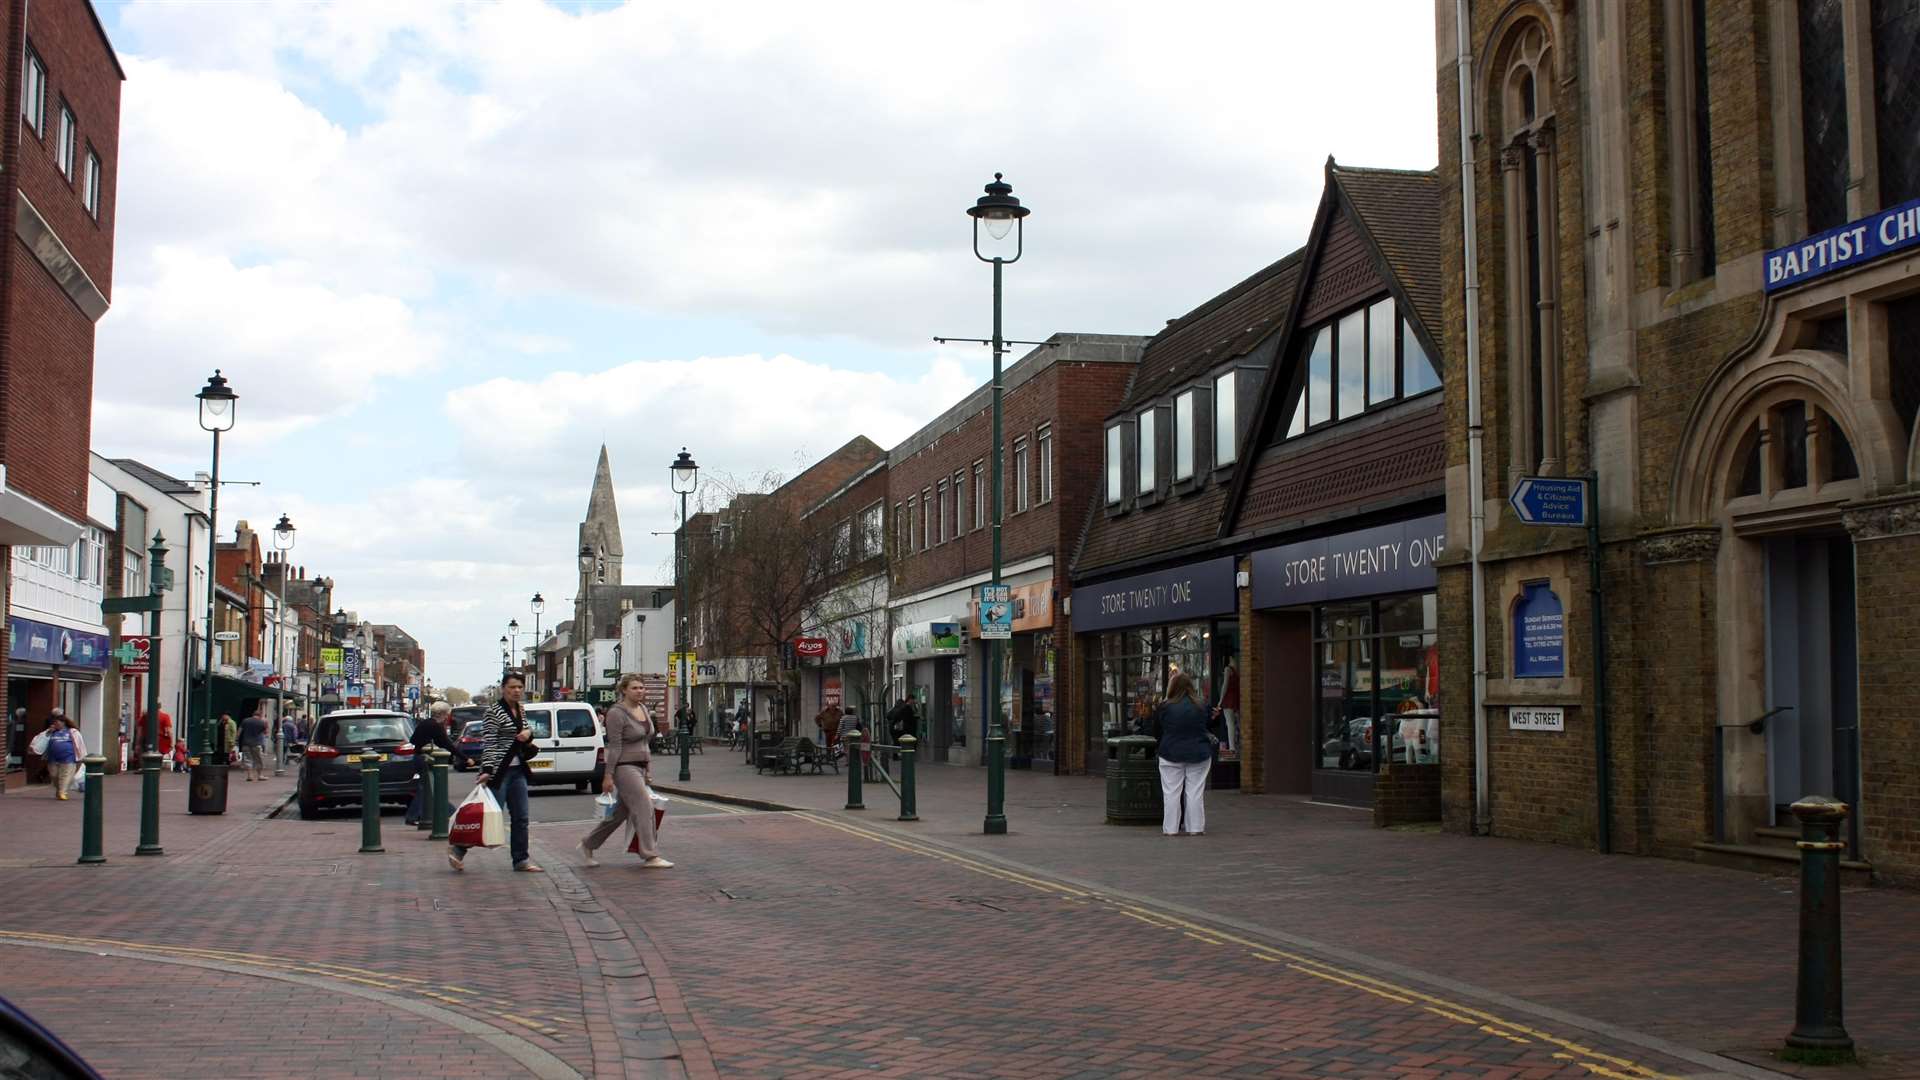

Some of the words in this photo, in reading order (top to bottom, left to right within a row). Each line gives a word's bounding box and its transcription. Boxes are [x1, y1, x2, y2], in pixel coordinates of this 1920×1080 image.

[1769, 225, 1866, 283] BAPTIST
[1879, 206, 1920, 246] CH
[1533, 484, 1566, 493] Housing
[1567, 484, 1580, 493] Aid
[1543, 493, 1576, 501] Citizens
[1542, 502, 1569, 510] Advice
[1285, 556, 1326, 587] STORE
[1333, 541, 1401, 579] TWENTY
[1101, 592, 1126, 615] STORE
[1129, 584, 1168, 609] TWENTY
[1171, 581, 1191, 604] ONE
[799, 641, 823, 651] Argos
[1512, 711, 1531, 725] WEST
[1534, 711, 1560, 726] STREET
